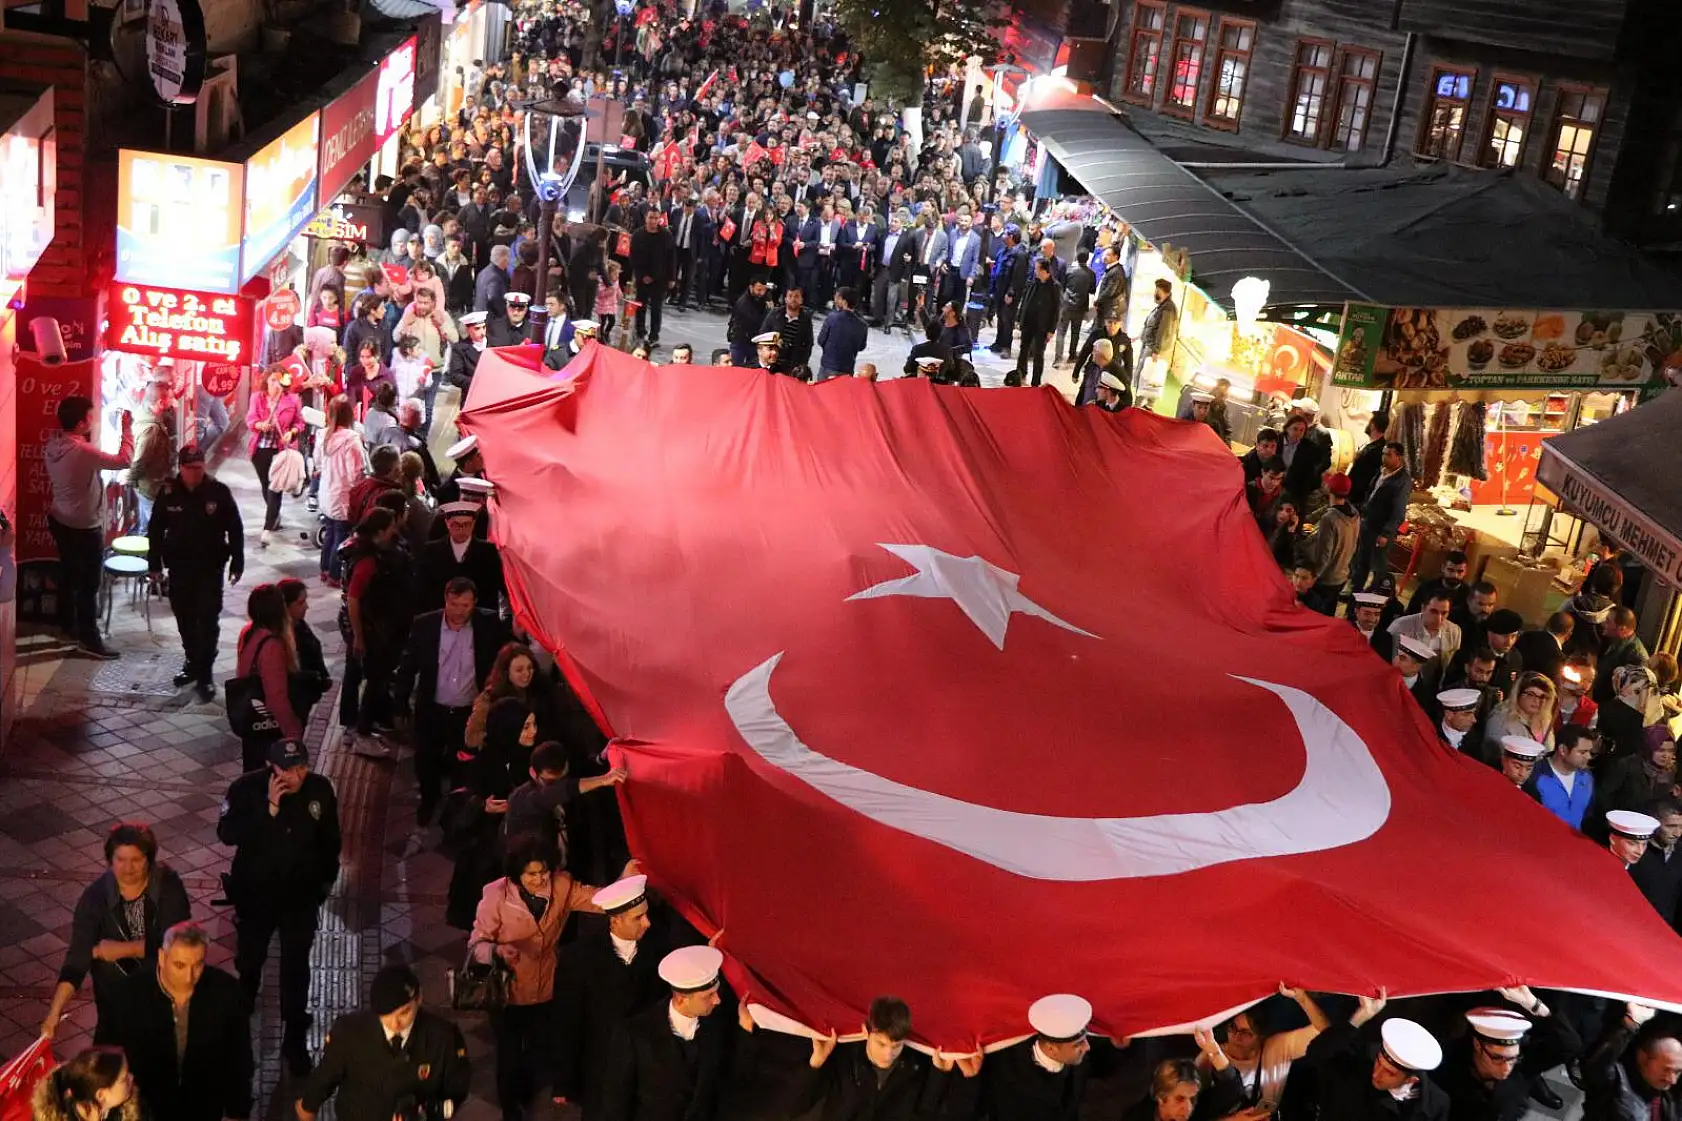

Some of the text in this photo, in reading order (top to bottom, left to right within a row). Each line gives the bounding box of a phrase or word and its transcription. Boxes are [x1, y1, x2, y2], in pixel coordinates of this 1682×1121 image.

[146, 291, 177, 308] ve
[183, 294, 206, 311] 2.
[128, 305, 225, 334] Telefon
[120, 325, 172, 353] Alış
[41, 382, 62, 397] ve
[1468, 375, 1503, 385] TOPTAN
[1561, 473, 1676, 574] KUYUMCU MEHMET
